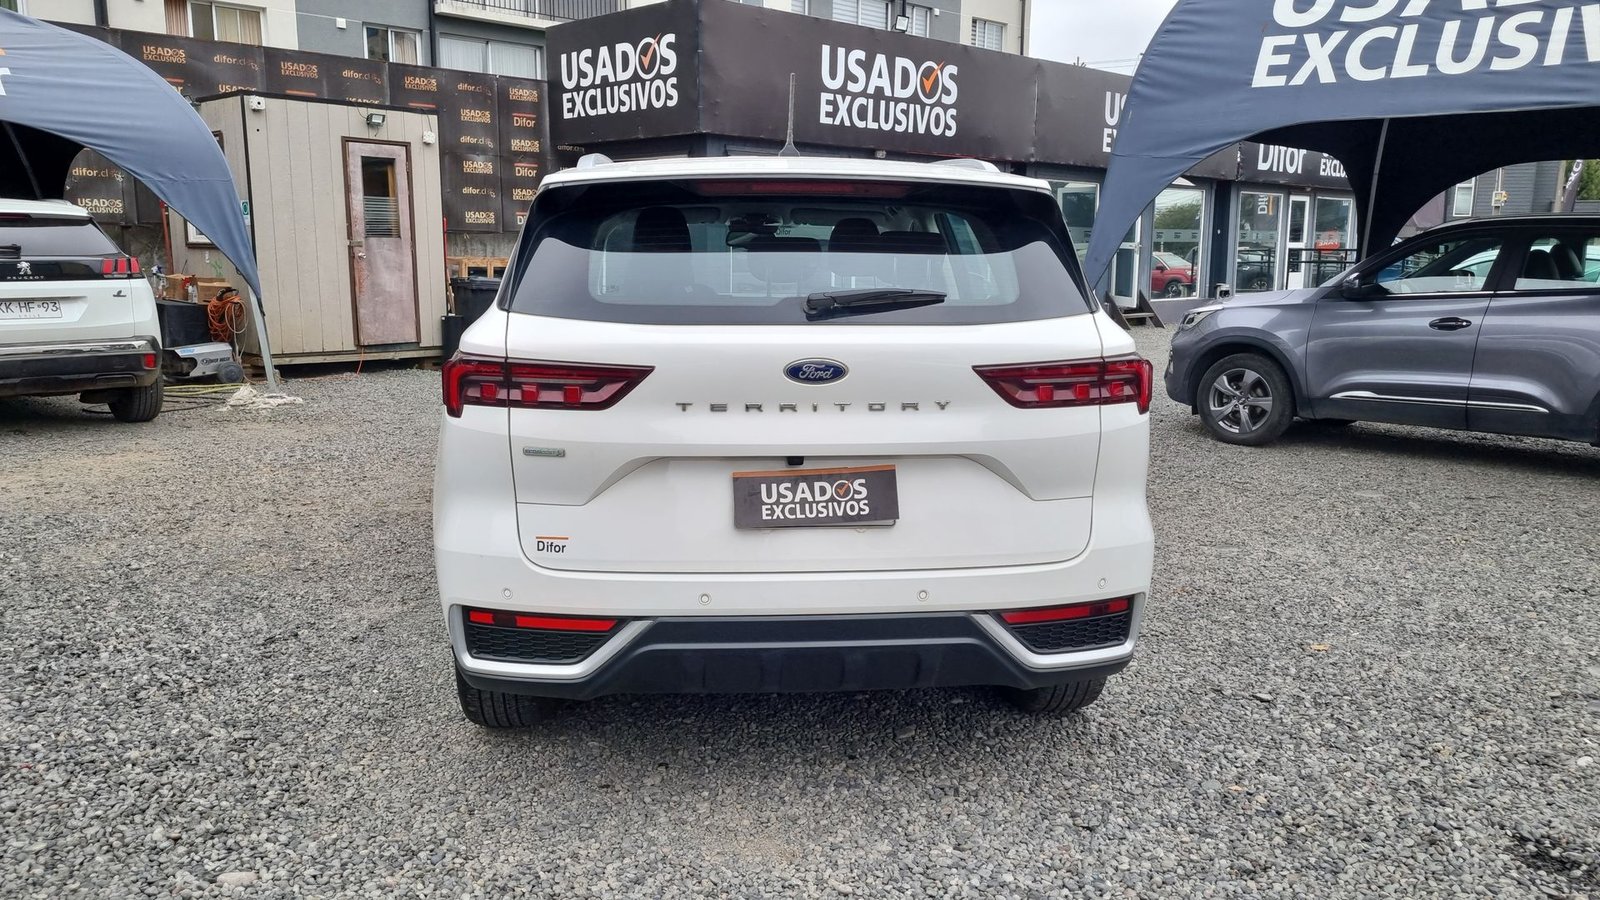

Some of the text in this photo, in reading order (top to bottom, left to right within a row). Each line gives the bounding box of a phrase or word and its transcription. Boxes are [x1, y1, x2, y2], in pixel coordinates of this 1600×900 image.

[143, 45, 186, 58] USADOS
[143, 53, 187, 64] EXCLUSIVOS
[213, 54, 246, 65] difor.cl
[561, 33, 677, 89] USADOS
[280, 61, 318, 73] USADOS
[281, 69, 318, 79] EXCLUSIVOS
[342, 69, 371, 80] difor.cl
[821, 44, 958, 105] USADOS
[404, 76, 437, 86] USADOS
[457, 82, 482, 93] difor.cl
[509, 87, 538, 97] USADOS
[562, 77, 678, 119] EXCLUSIVOS
[460, 108, 491, 118] USADOS
[819, 92, 957, 137] EXCLUSIVOS
[513, 116, 536, 127] Difor
[460, 135, 485, 144] difor.cl
[511, 139, 540, 148] USADOS
[463, 160, 492, 169] USADOS
[72, 167, 109, 177] difor.cl
[515, 167, 537, 177] Difor
[462, 186, 487, 195] difor.cl
[77, 197, 123, 208] USADOS
[465, 211, 495, 219] USADOS
[798, 363, 834, 379] Ford
[676, 400, 951, 413] TERRITORY
[760, 478, 868, 504] USADOS
[761, 500, 870, 520] EXCLUSIVOS
[536, 540, 567, 553] Difor
